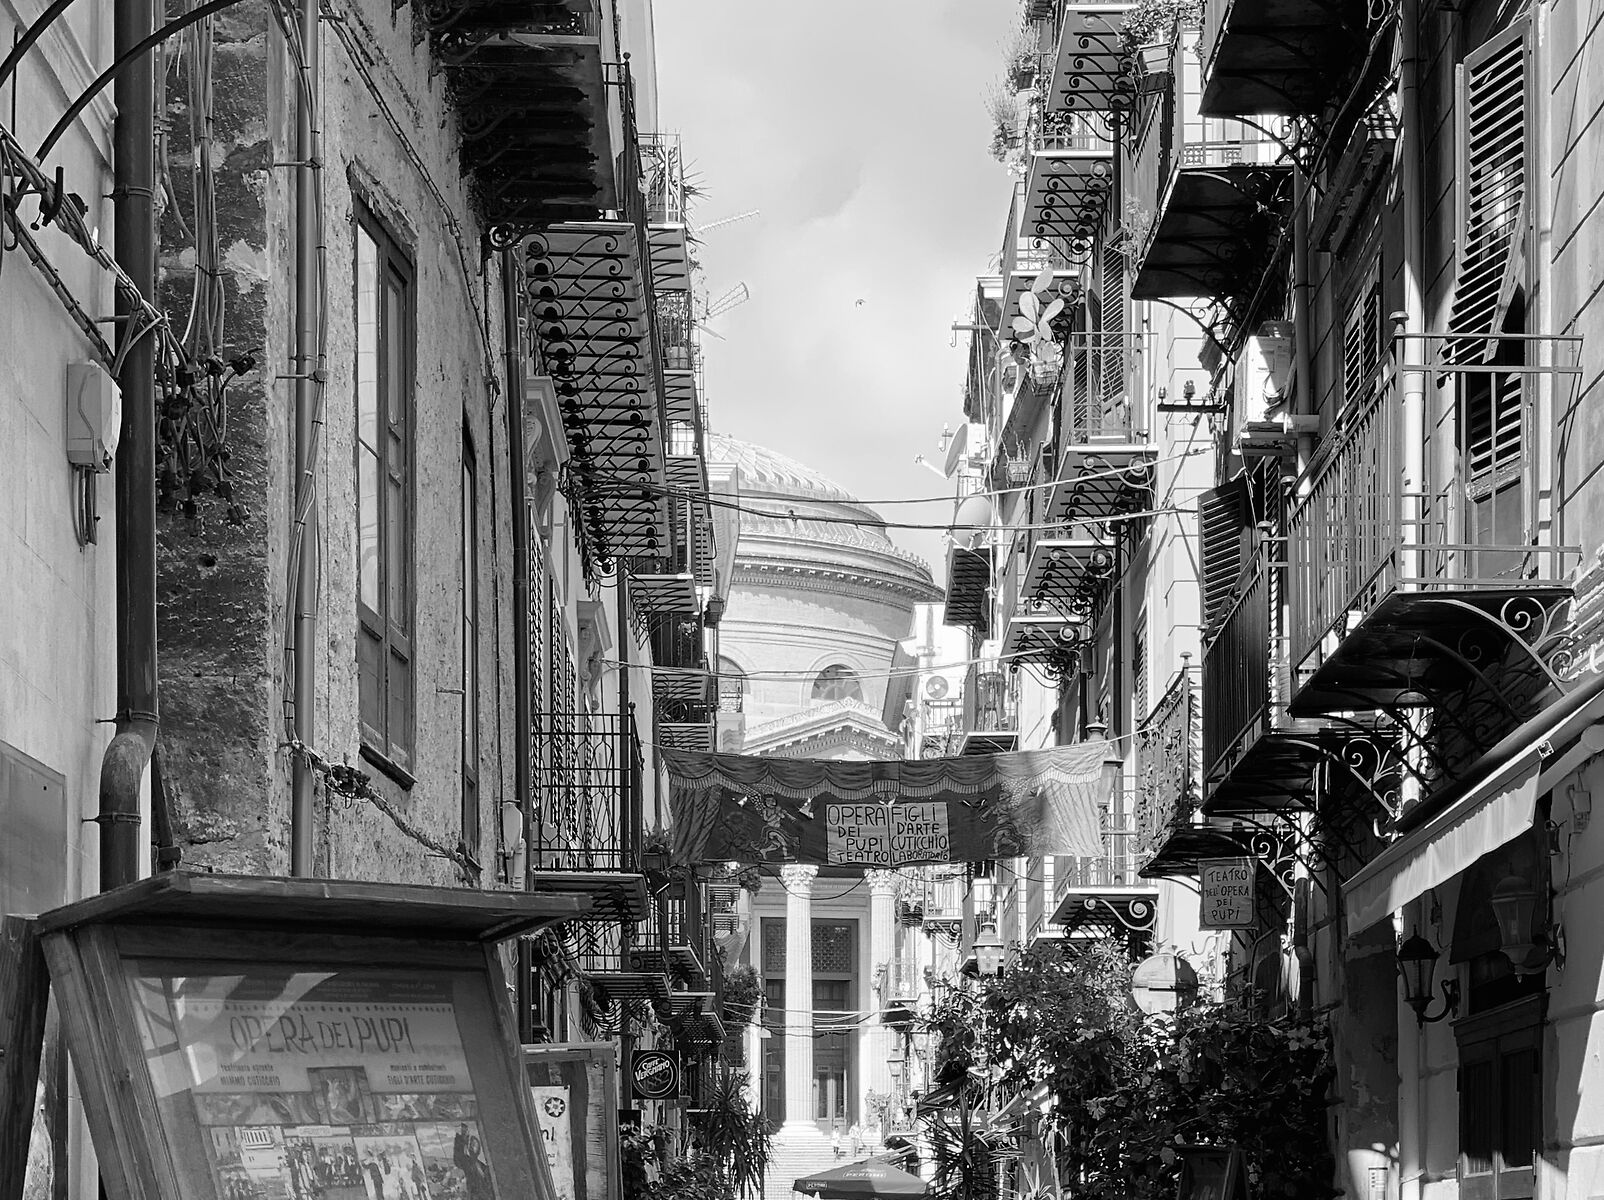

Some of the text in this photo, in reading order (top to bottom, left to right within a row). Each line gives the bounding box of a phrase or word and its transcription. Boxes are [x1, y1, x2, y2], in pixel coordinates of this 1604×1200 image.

[828, 805, 886, 826] OPERA
[891, 804, 936, 824] FIGLI
[838, 826, 860, 838] DEI
[897, 822, 939, 835] D'ARTE
[846, 835, 883, 851] PUPI
[891, 835, 947, 850] CUTICCHIO
[837, 850, 889, 862] TEATRO
[892, 850, 948, 862] LABORATORIO
[1208, 868, 1248, 882] TEATRO
[1216, 896, 1232, 907] DEI
[1211, 906, 1240, 920] PUPI
[230, 1014, 415, 1054] OPERA DEI PUPI
